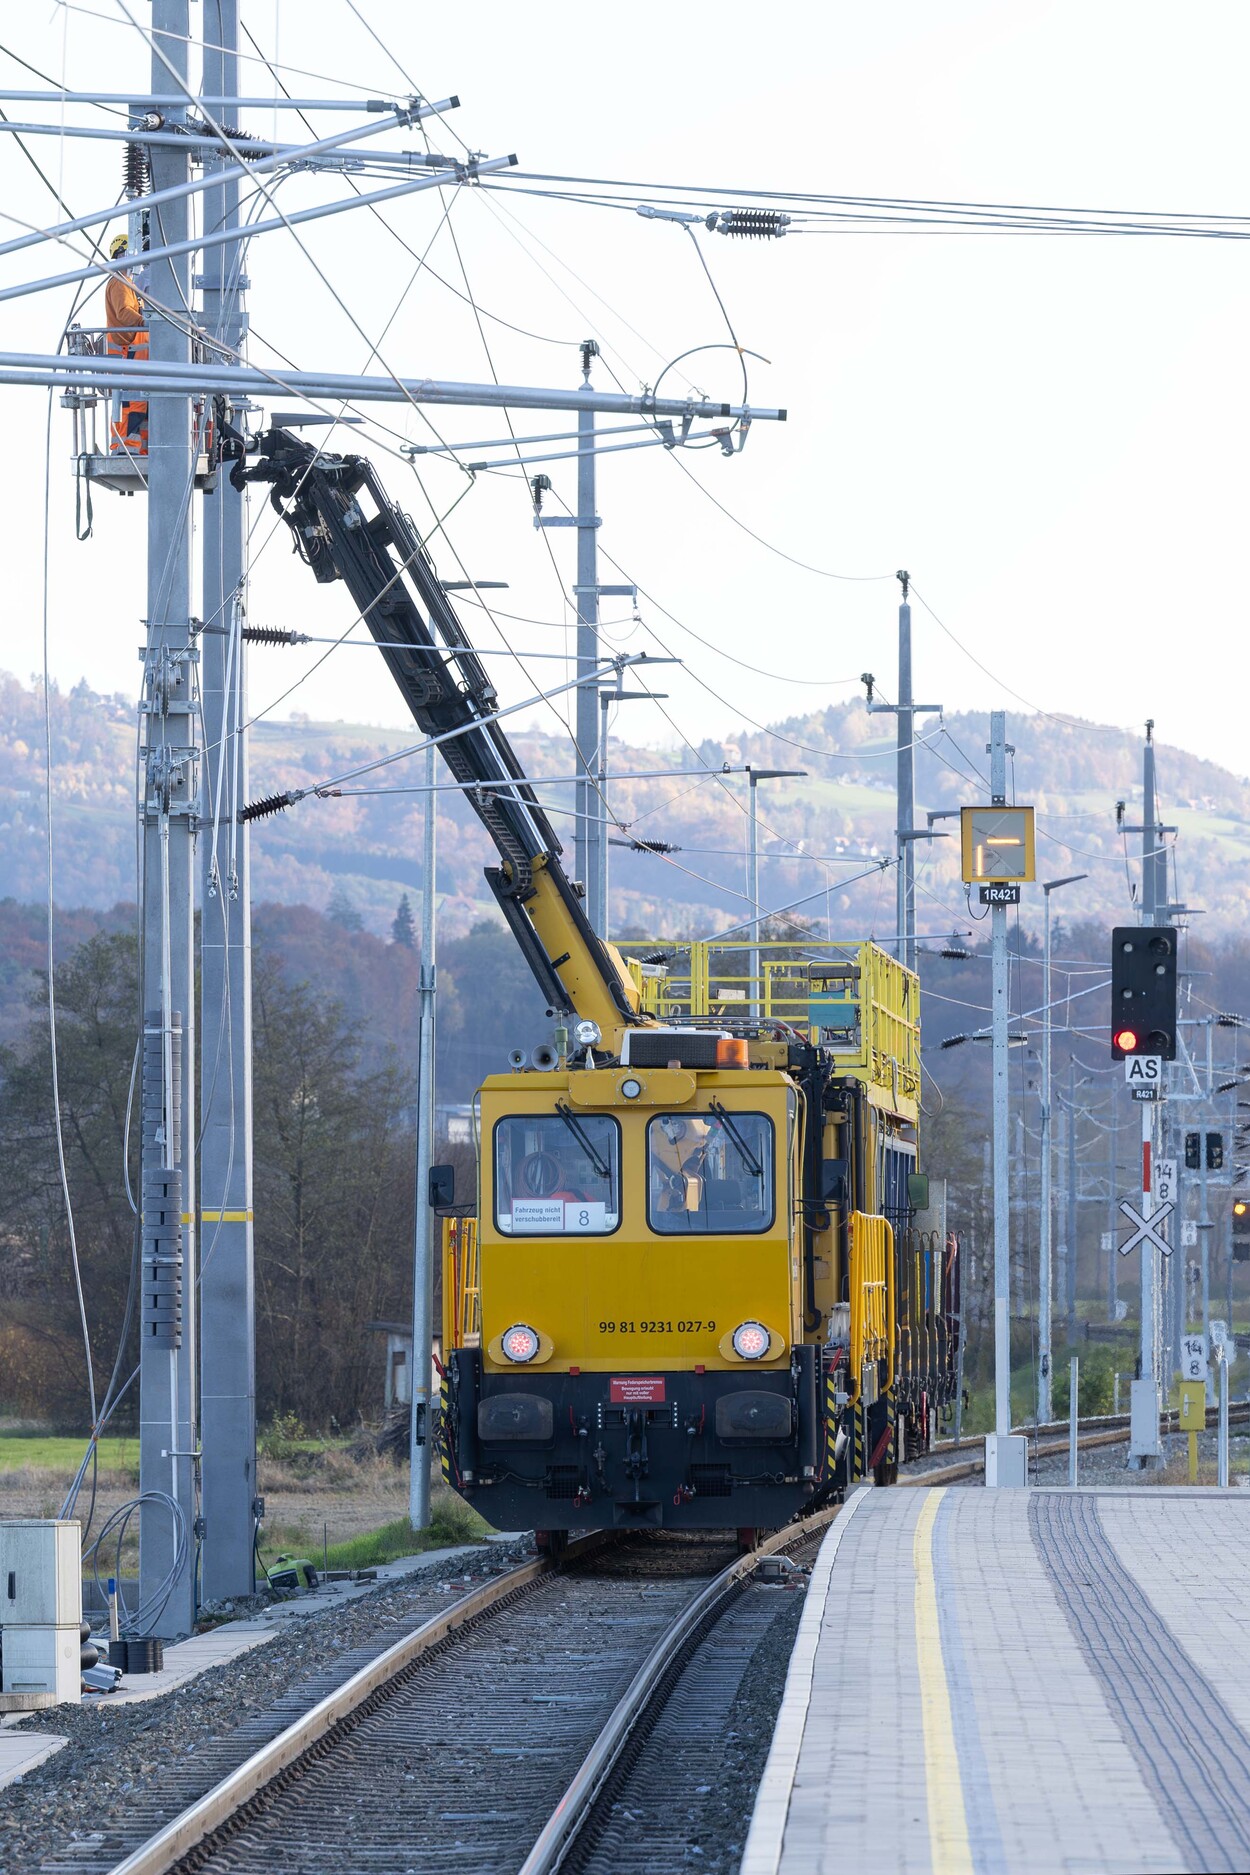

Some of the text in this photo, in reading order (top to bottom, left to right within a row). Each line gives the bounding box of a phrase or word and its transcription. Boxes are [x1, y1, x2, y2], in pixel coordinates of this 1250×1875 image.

[984, 889, 1016, 900] 1R421
[1129, 1059, 1158, 1079] AS
[1136, 1090, 1153, 1098] R421
[1156, 1164, 1172, 1180] 14
[1160, 1183, 1169, 1199] 8
[579, 1210, 589, 1226] 8
[599, 1320, 716, 1333] 99 81 9231 027-9
[1184, 1340, 1202, 1356] 14
[1190, 1360, 1200, 1375] 8
